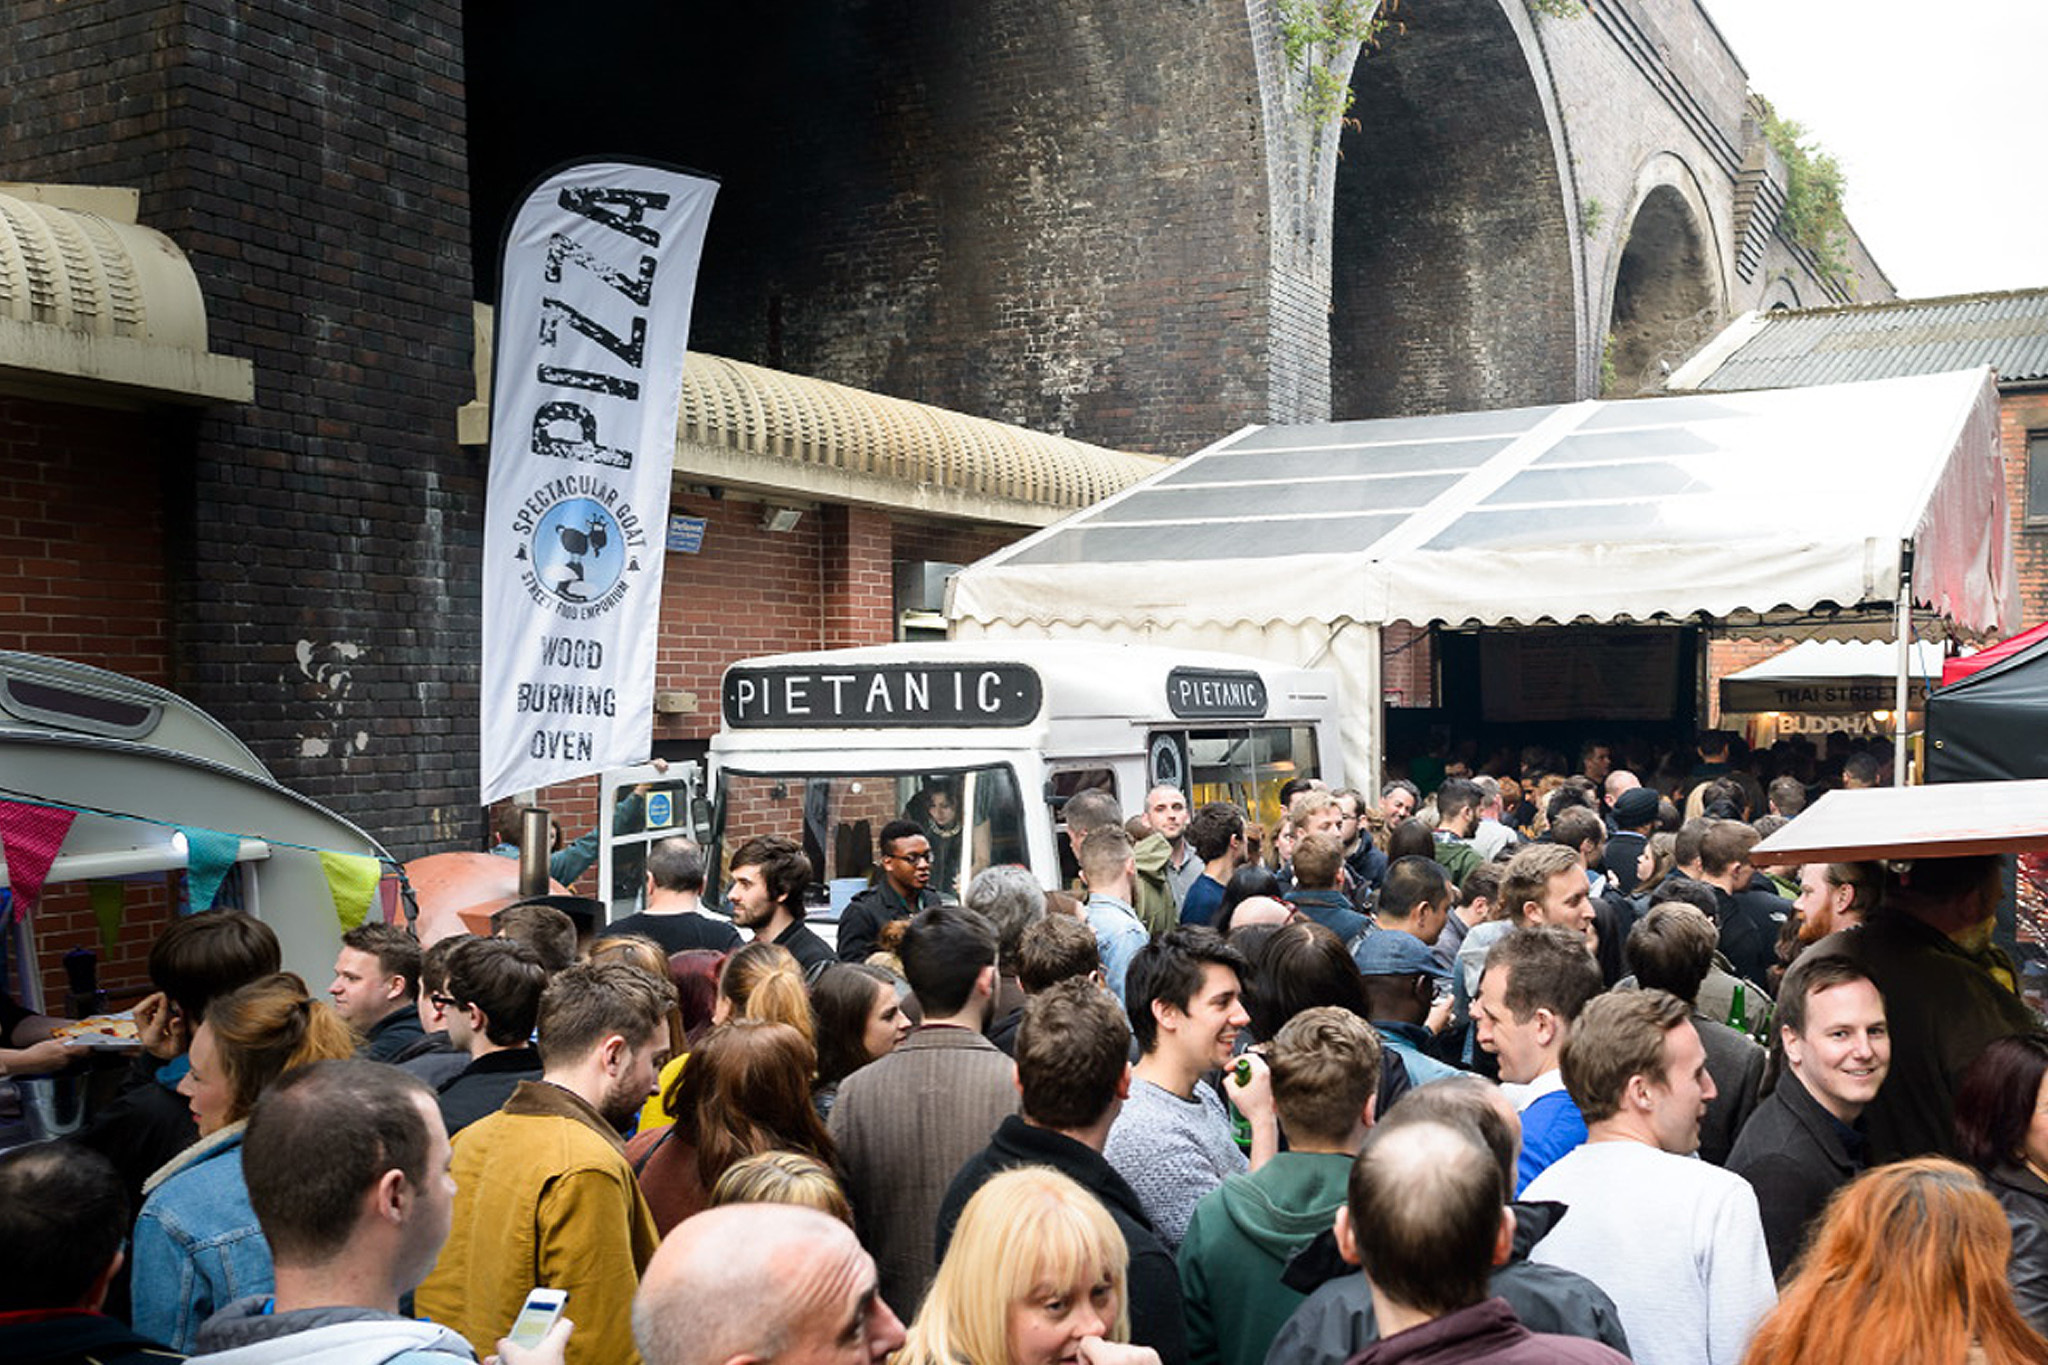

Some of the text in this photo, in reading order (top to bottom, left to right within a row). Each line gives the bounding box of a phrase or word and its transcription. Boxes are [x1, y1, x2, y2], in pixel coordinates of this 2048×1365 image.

[531, 187, 670, 469] PIZZA
[512, 475, 619, 536] SPECTACULAR
[616, 503, 647, 547] GOAT
[521, 571, 630, 620] STREET FOOD EMPORIUM
[540, 636, 603, 670] WOOD
[517, 682, 616, 717] BURNING
[737, 671, 1001, 718] PIETANIC
[1179, 679, 1258, 707] PIETANIC
[1776, 688, 1819, 704] THAI
[1779, 714, 1878, 734] BUDDHA
[529, 730, 593, 761] OVEN
